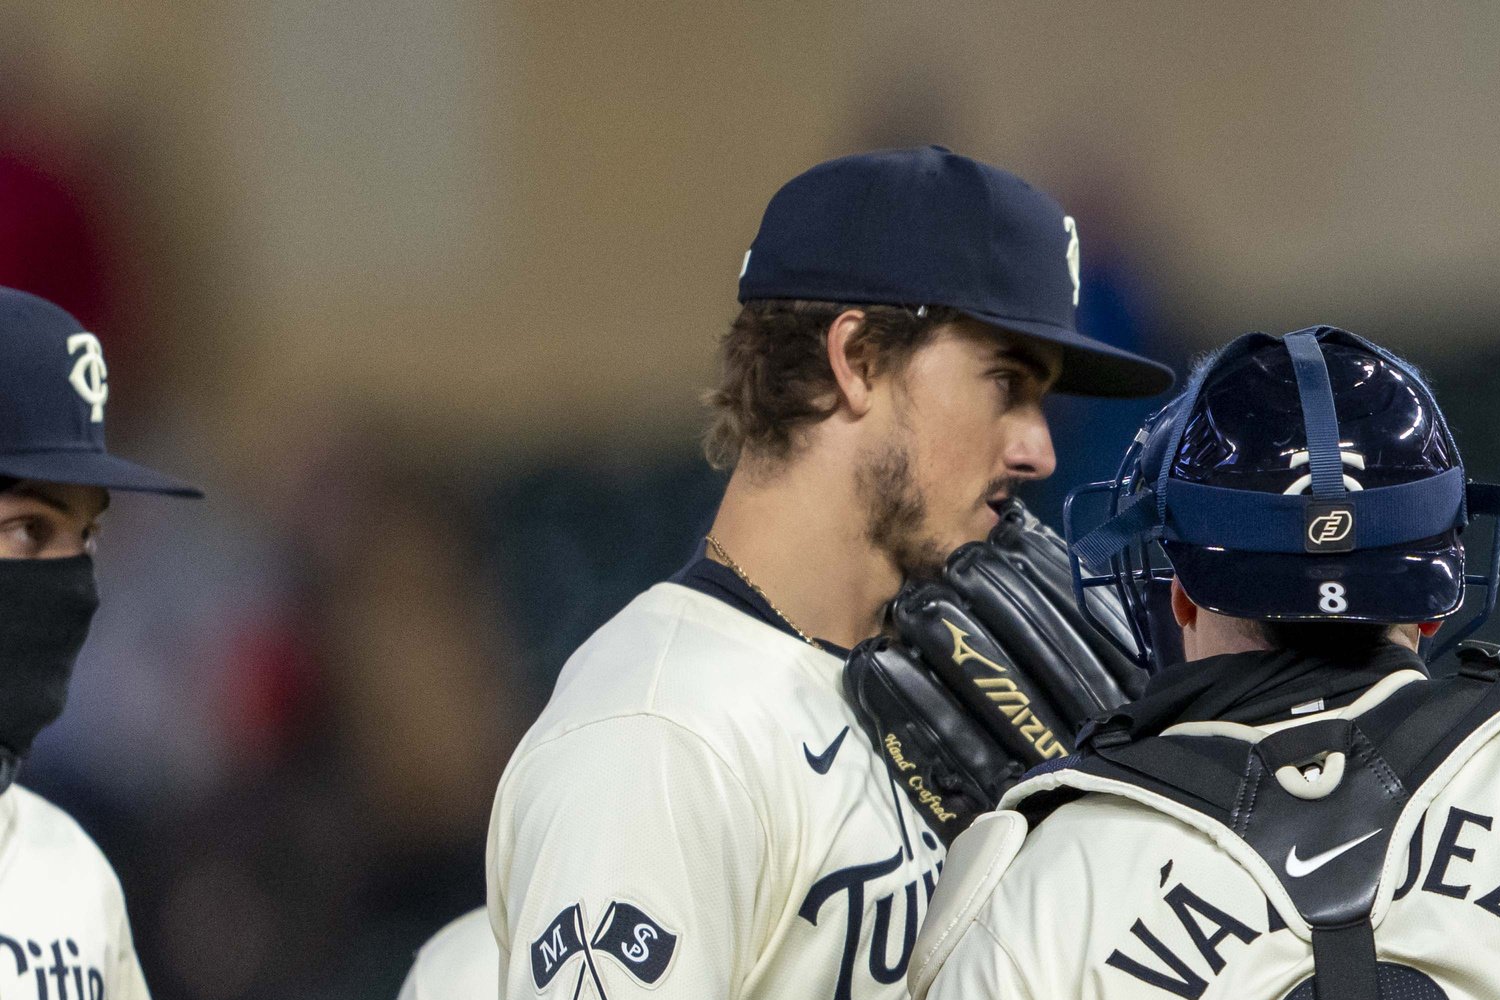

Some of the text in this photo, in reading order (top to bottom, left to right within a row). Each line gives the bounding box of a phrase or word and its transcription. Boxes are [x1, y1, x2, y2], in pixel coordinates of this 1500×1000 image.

[1318, 581, 1348, 613] 8
[884, 733, 957, 822] Hand Crafted
[539, 924, 568, 973] M
